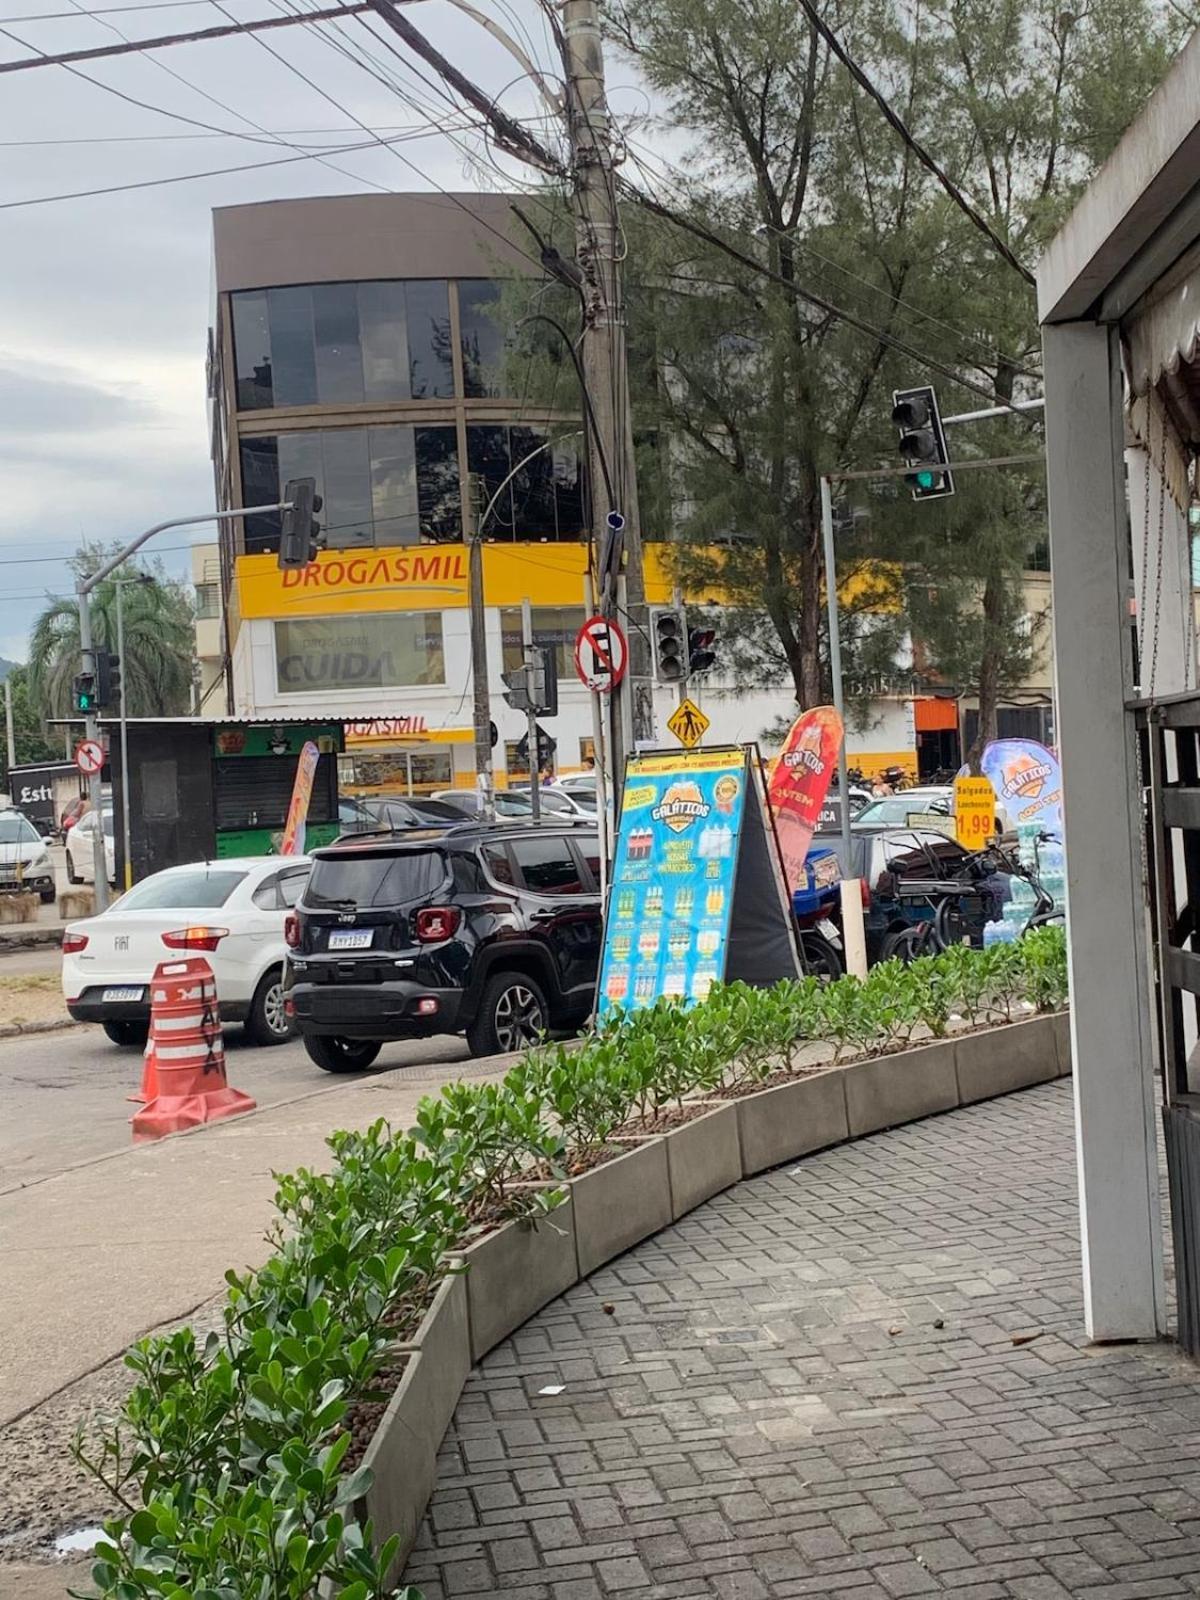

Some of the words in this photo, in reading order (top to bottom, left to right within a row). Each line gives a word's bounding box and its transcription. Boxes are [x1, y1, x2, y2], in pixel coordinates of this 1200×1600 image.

[282, 555, 467, 588] DROGASMIL
[592, 633, 610, 675] E
[958, 815, 991, 838] 1,99
[338, 913, 356, 924] Jeep
[114, 936, 130, 951] FIAT
